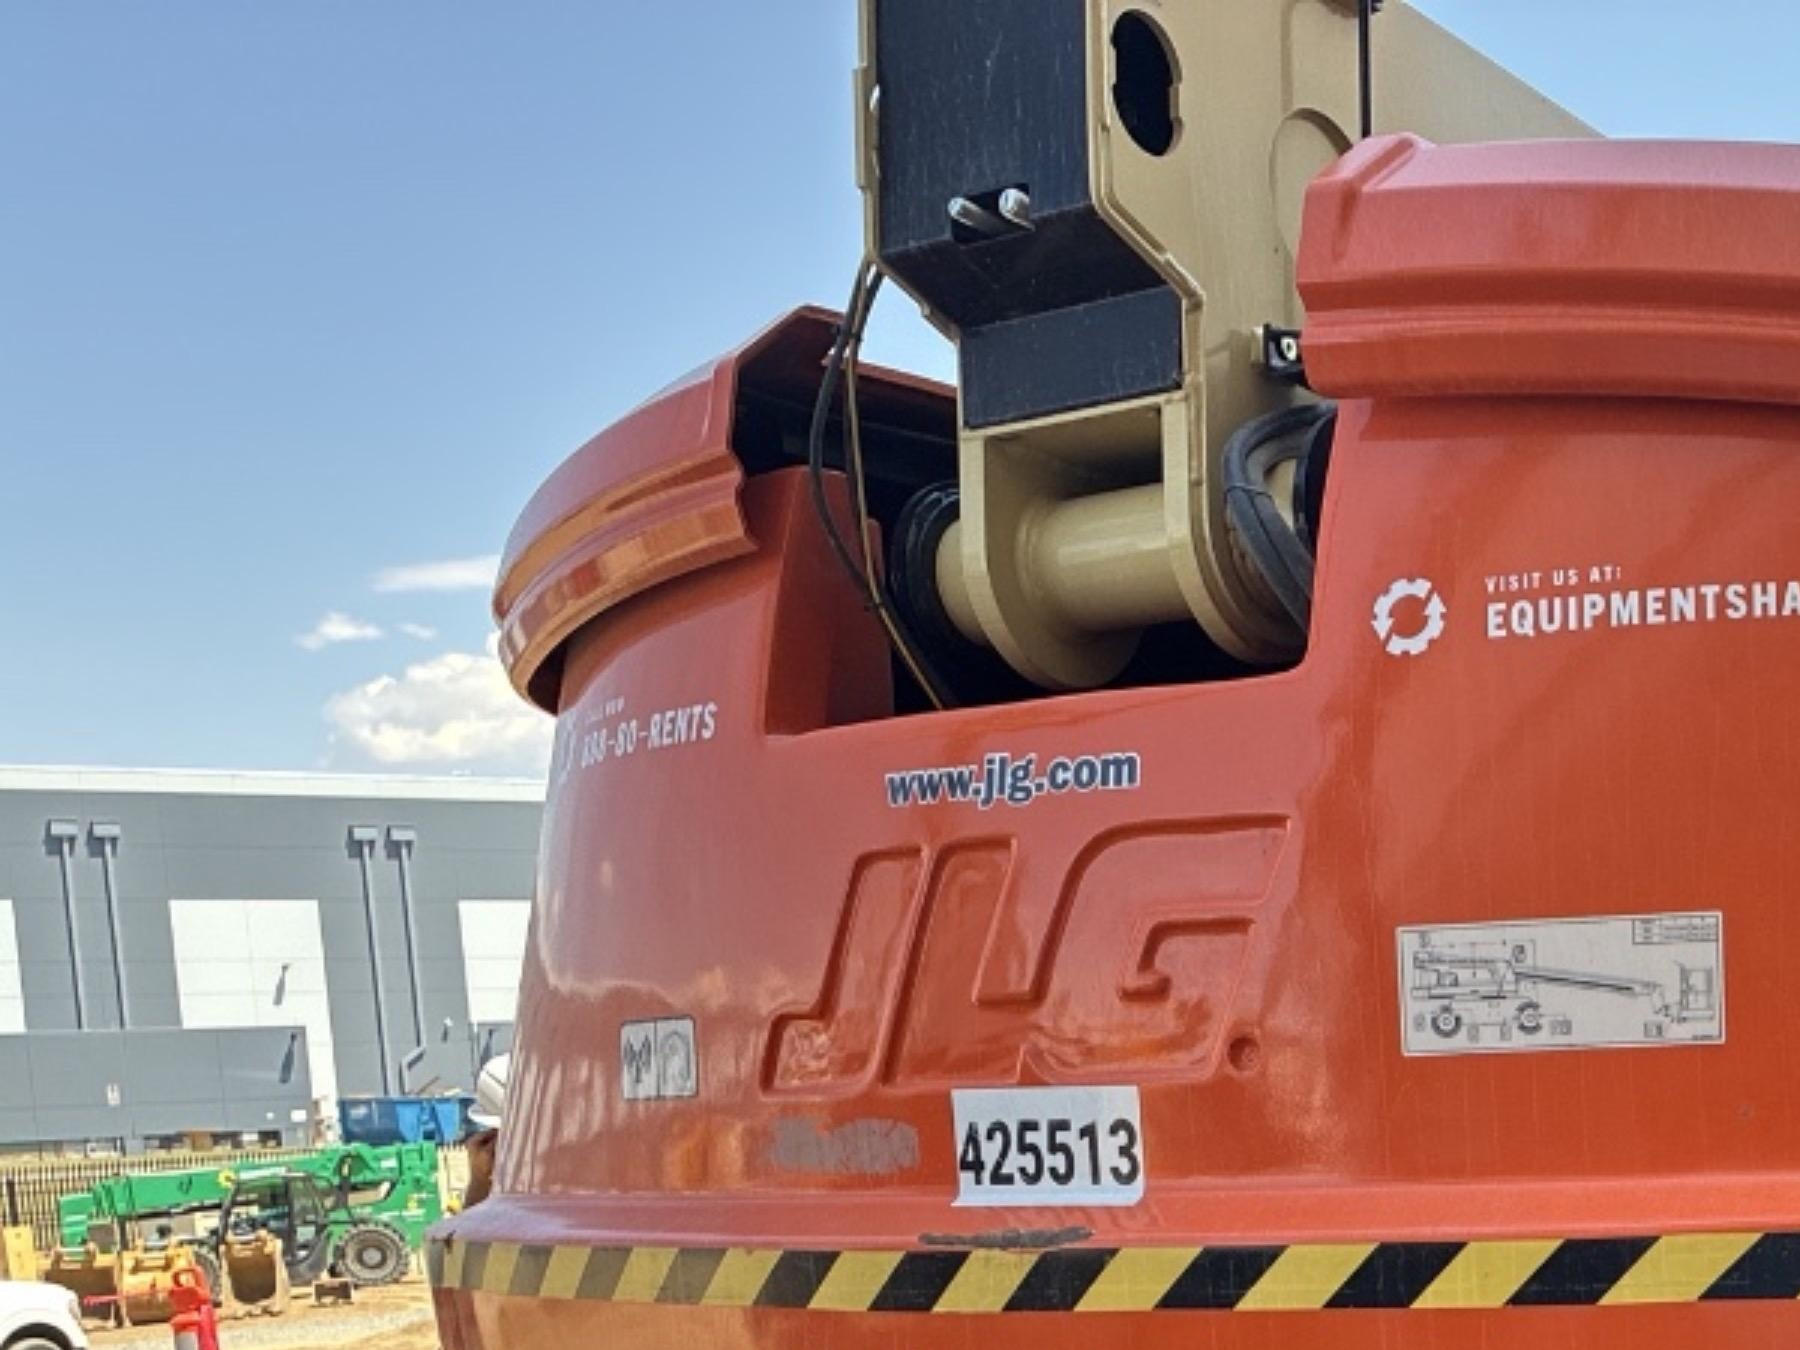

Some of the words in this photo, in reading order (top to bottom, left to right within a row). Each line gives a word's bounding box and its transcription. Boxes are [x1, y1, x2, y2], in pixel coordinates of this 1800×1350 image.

[1485, 572, 1542, 594] VISIT
[1553, 568, 1579, 587] US
[1590, 565, 1622, 584] AT:
[886, 750, 1141, 809] www.jlg.com
[760, 814, 1292, 1097] JLG
[958, 1118, 1140, 1186] 425513
